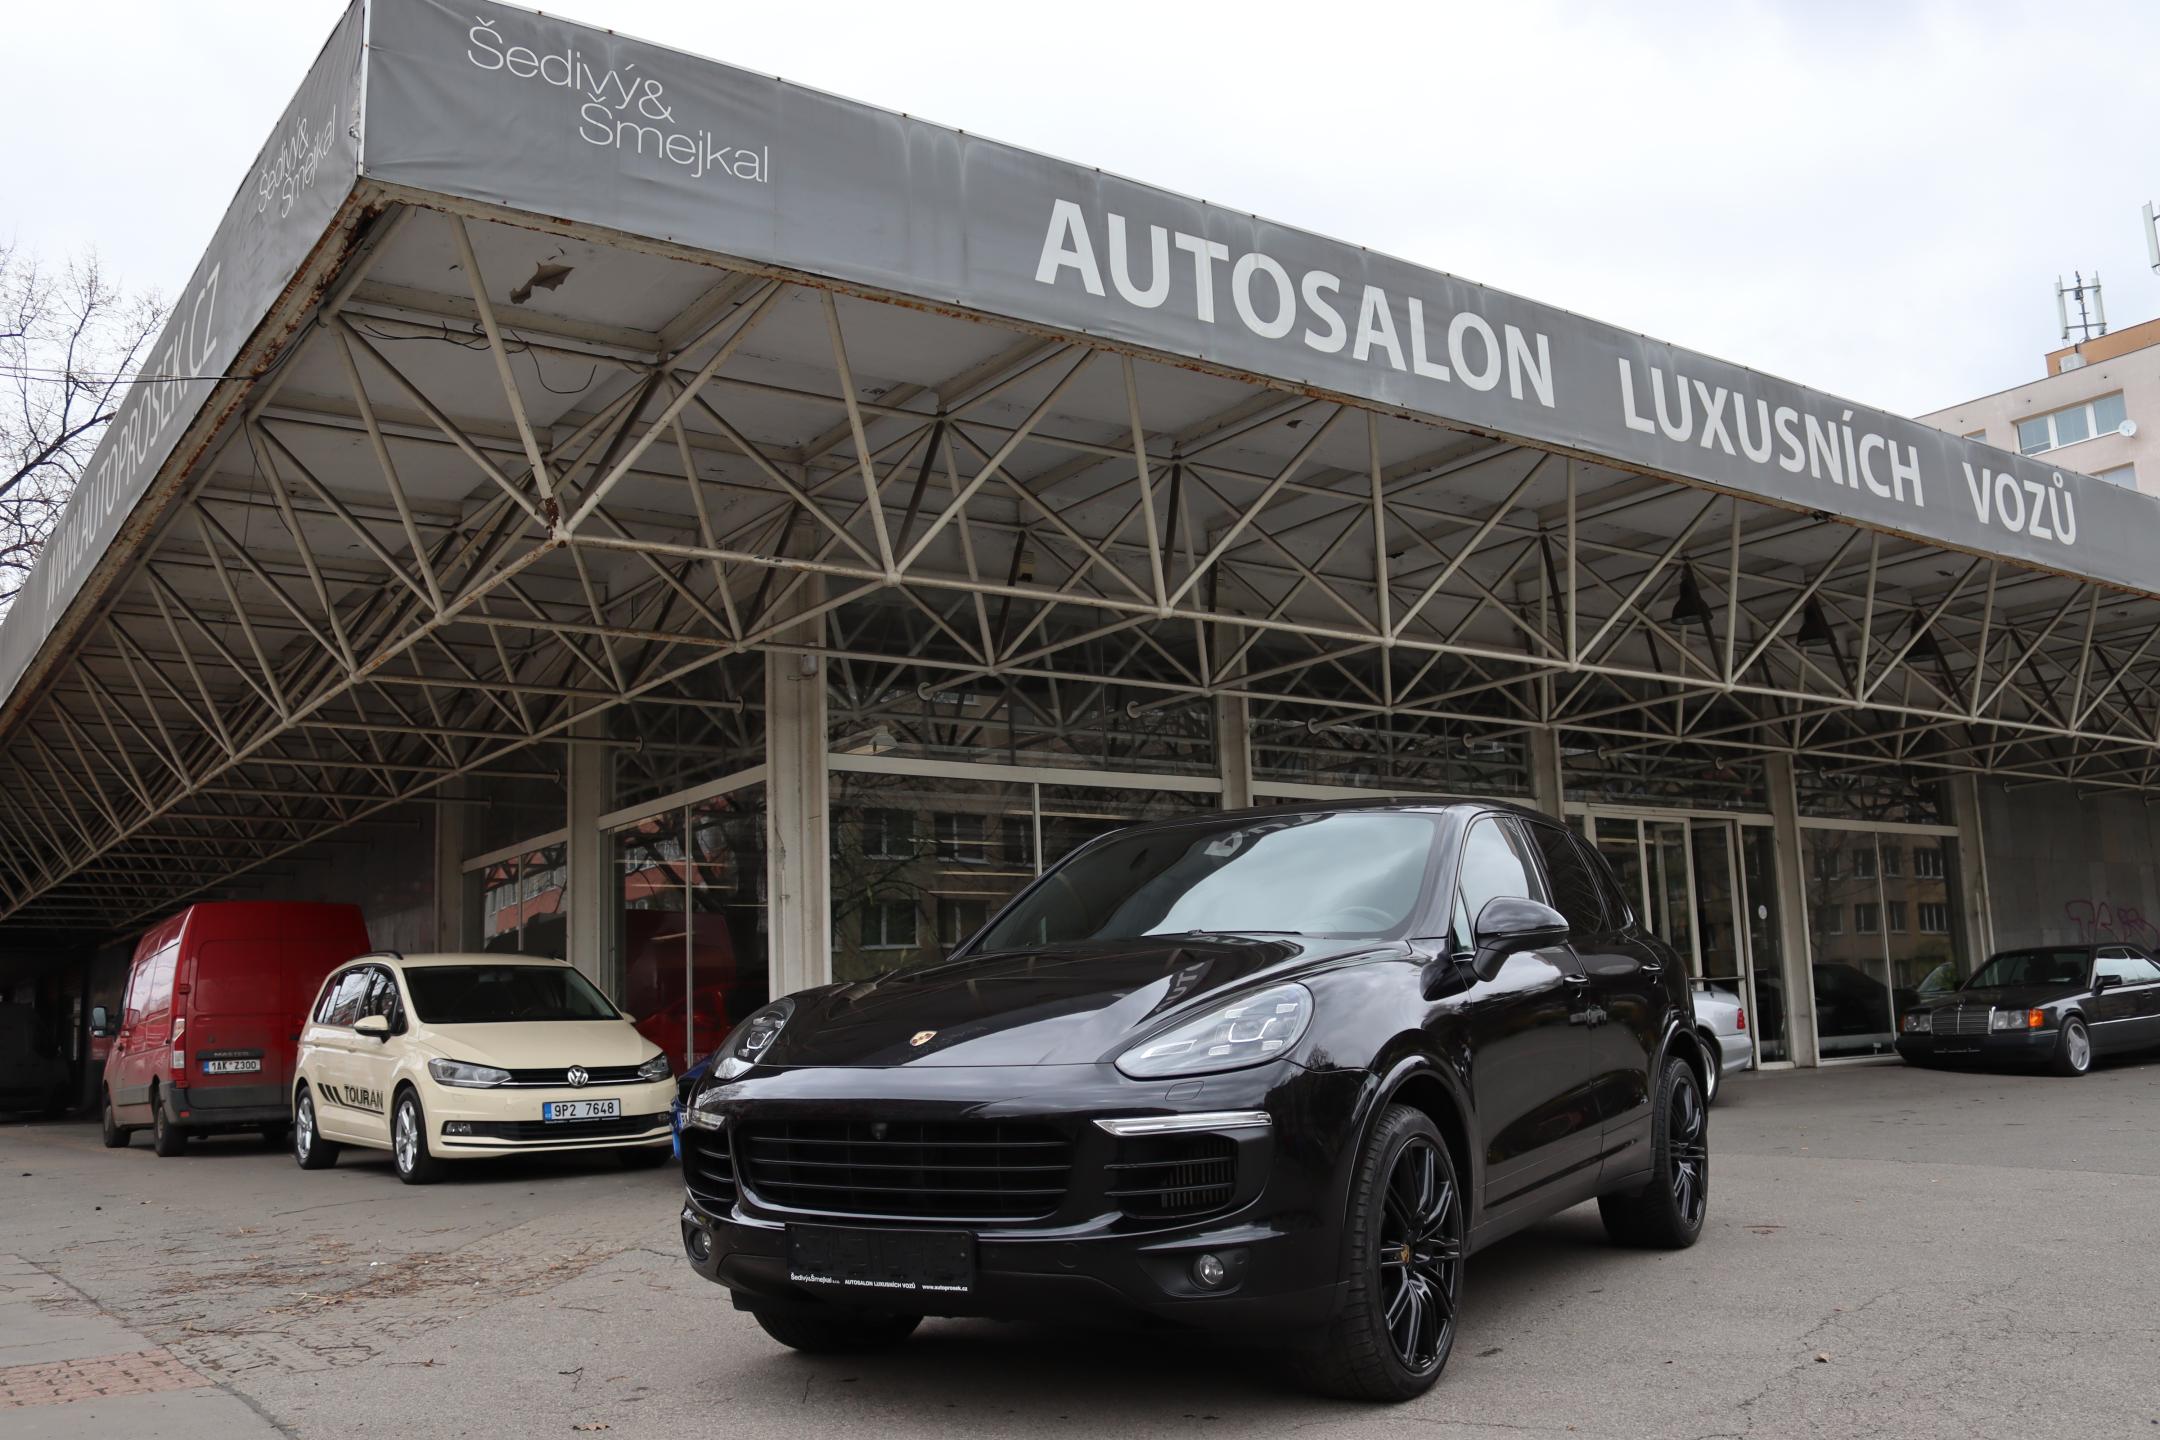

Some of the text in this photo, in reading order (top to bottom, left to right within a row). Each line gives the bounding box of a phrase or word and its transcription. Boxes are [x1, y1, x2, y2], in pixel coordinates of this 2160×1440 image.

[579, 92, 768, 183] Šmejkal
[1035, 198, 2077, 545] AUTOSALON LUXUSNÍCH VOZŮ
[344, 1085, 384, 1110] TOURAN
[554, 1102, 614, 1117] 9P2 7648
